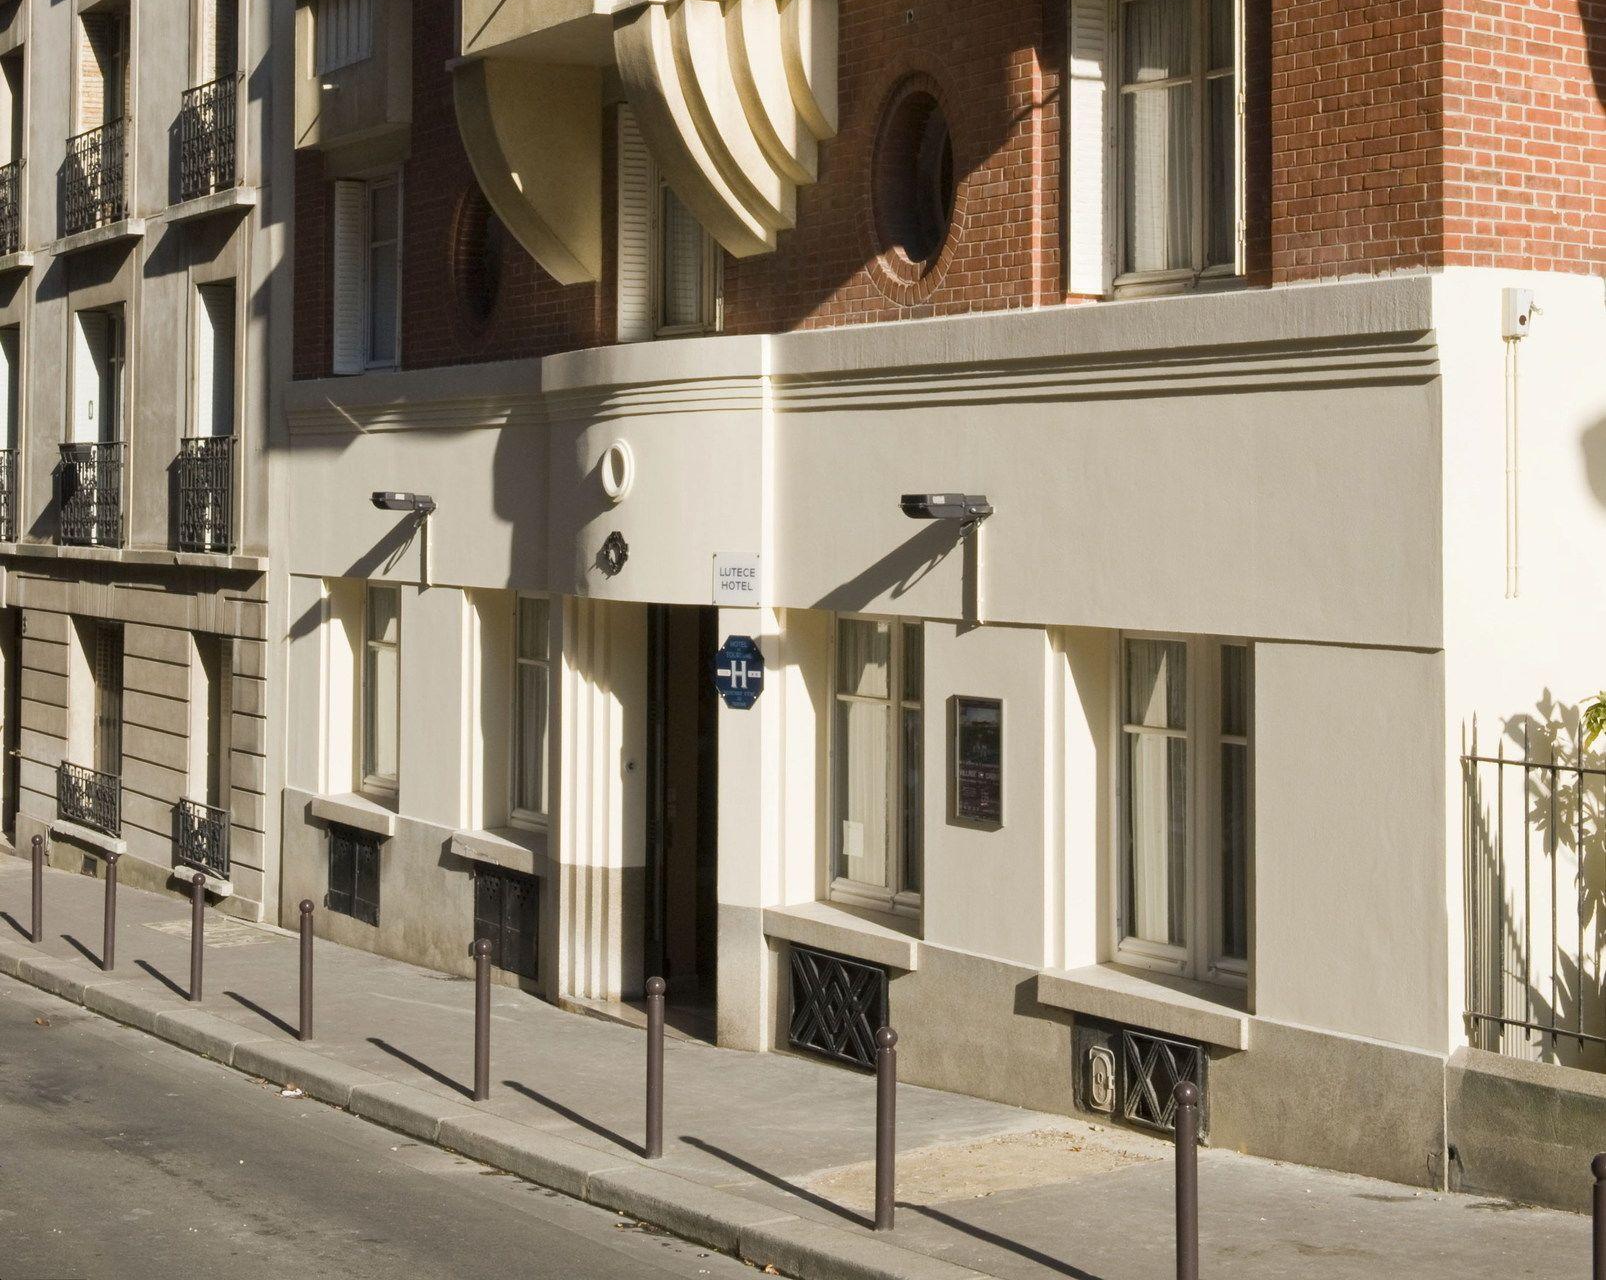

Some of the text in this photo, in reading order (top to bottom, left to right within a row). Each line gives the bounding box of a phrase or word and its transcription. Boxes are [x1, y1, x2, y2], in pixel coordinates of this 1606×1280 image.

[719, 567, 756, 578] LUTECE
[721, 580, 754, 591] HOTEL
[730, 660, 748, 689] H
